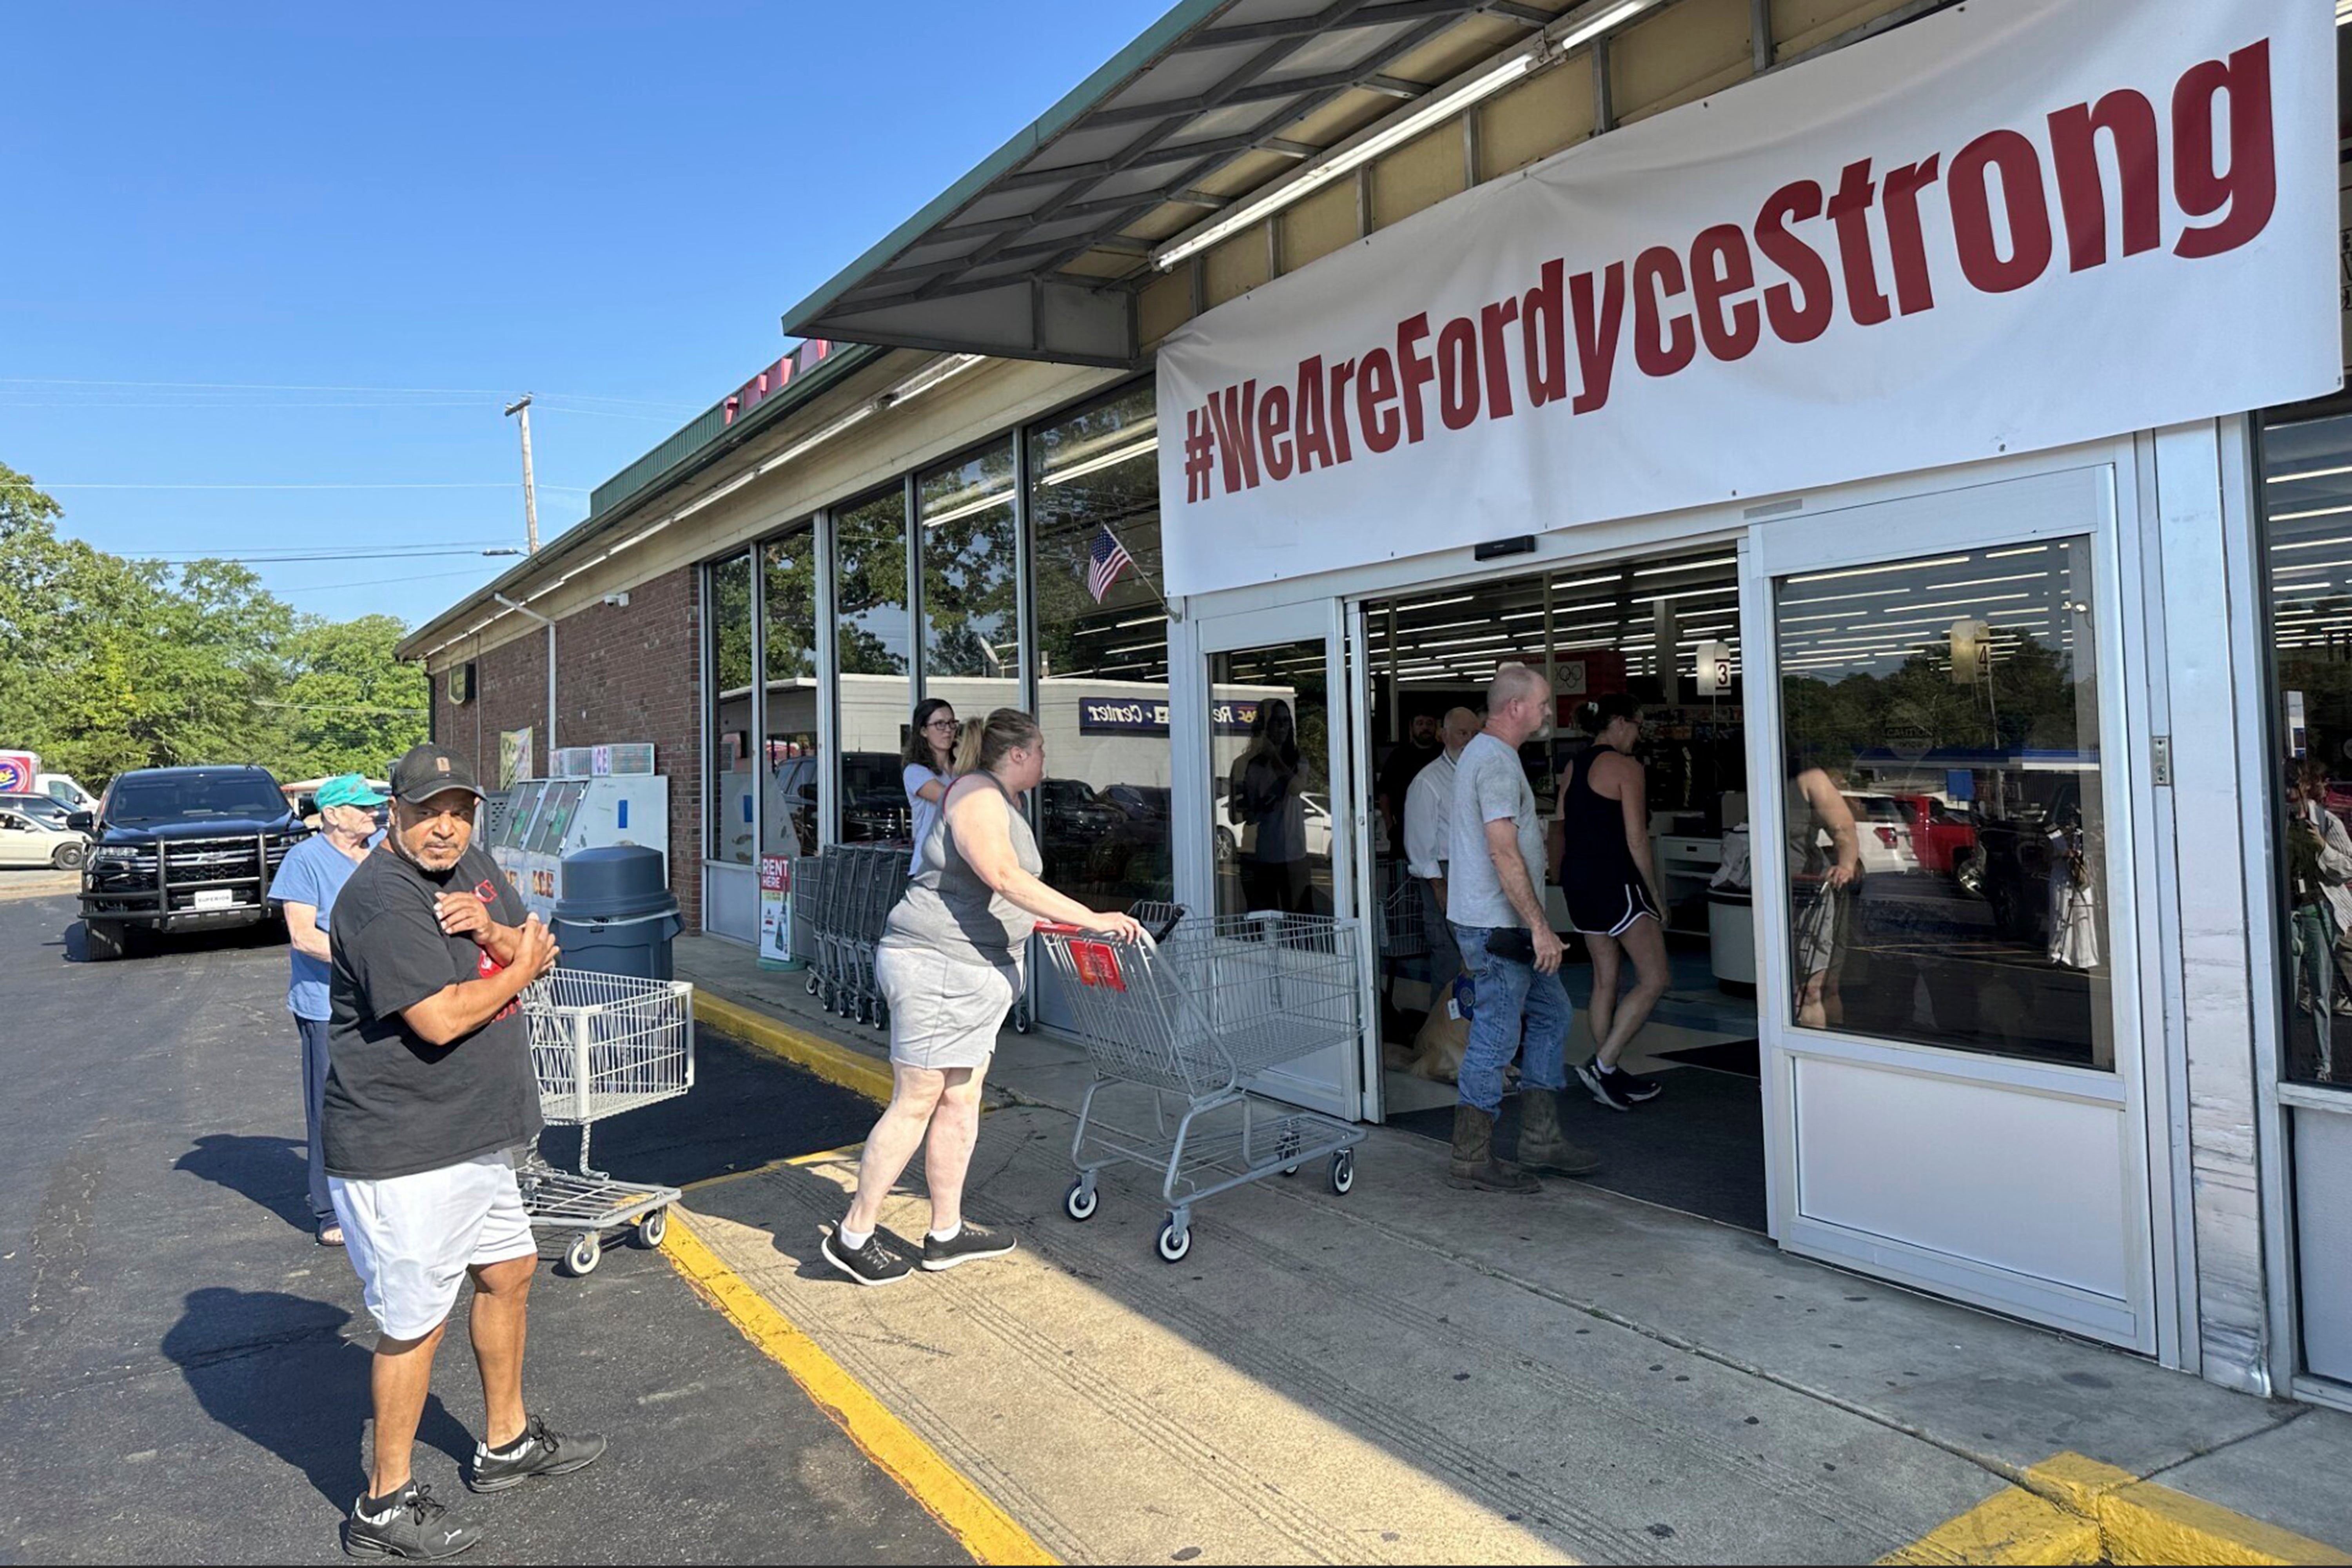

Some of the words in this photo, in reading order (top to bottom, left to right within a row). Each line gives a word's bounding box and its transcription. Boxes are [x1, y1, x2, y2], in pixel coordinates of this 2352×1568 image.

[1185, 40, 2275, 504] #WeAreFordyceStrong
[1978, 645, 1988, 670] 4
[1718, 664, 1728, 685] 3
[762, 858, 788, 877] RENT
[532, 869, 554, 898] ICE
[762, 876, 780, 888] HERE
